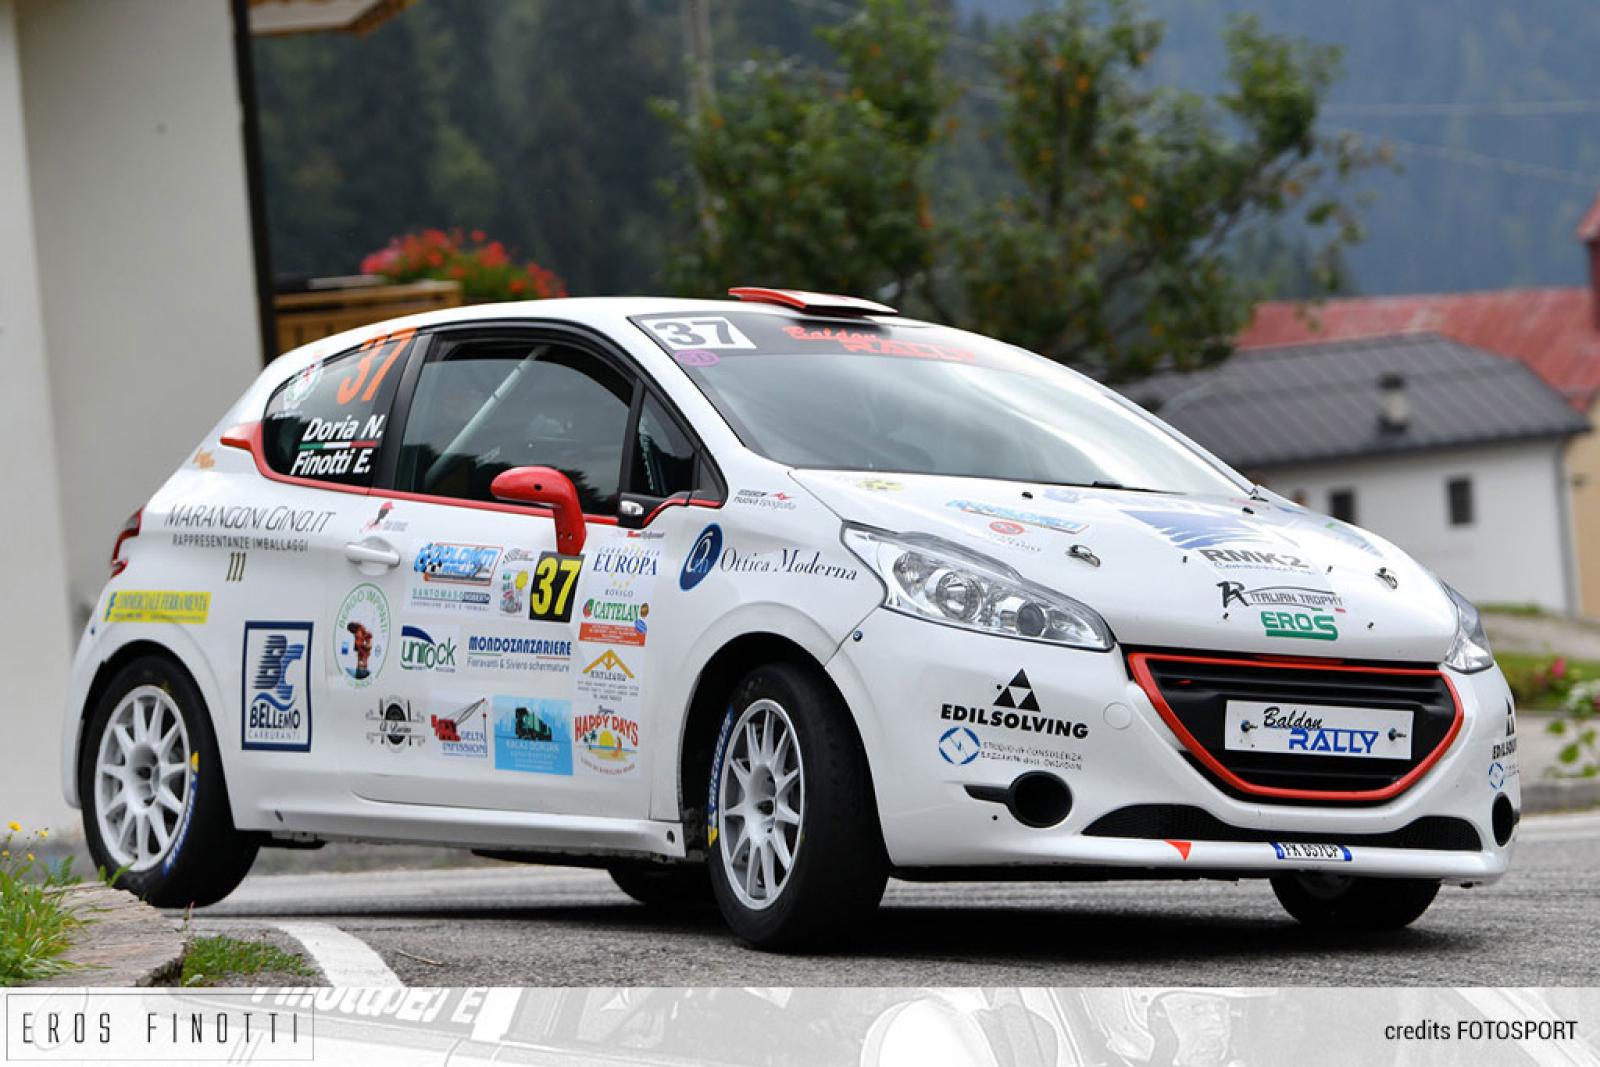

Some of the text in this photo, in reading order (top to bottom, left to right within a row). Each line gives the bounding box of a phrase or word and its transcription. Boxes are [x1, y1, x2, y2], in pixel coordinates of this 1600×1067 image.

[653, 321, 736, 346] 37
[337, 329, 416, 405] 37
[302, 414, 385, 441] Doria N.
[291, 449, 373, 475] Finotti E.
[172, 534, 309, 552] RAPPRESENTANZE IMBALLAGGI
[593, 552, 658, 576] EUROPA
[720, 547, 858, 582] Ottica Moderna
[1198, 549, 1310, 569] RMK2
[531, 558, 581, 616] 37
[1249, 592, 1299, 604] ITALIAN
[593, 601, 639, 622] CATTELAN
[1260, 611, 1338, 641] EROS
[469, 635, 571, 656] MONDOZANZARIERE
[250, 703, 301, 729] BELLEMO
[940, 703, 1089, 739] EDILSOLVING
[1263, 706, 1323, 730] Baldon
[574, 714, 639, 747] HAPPY DAYS
[1288, 727, 1380, 753] RALLY
